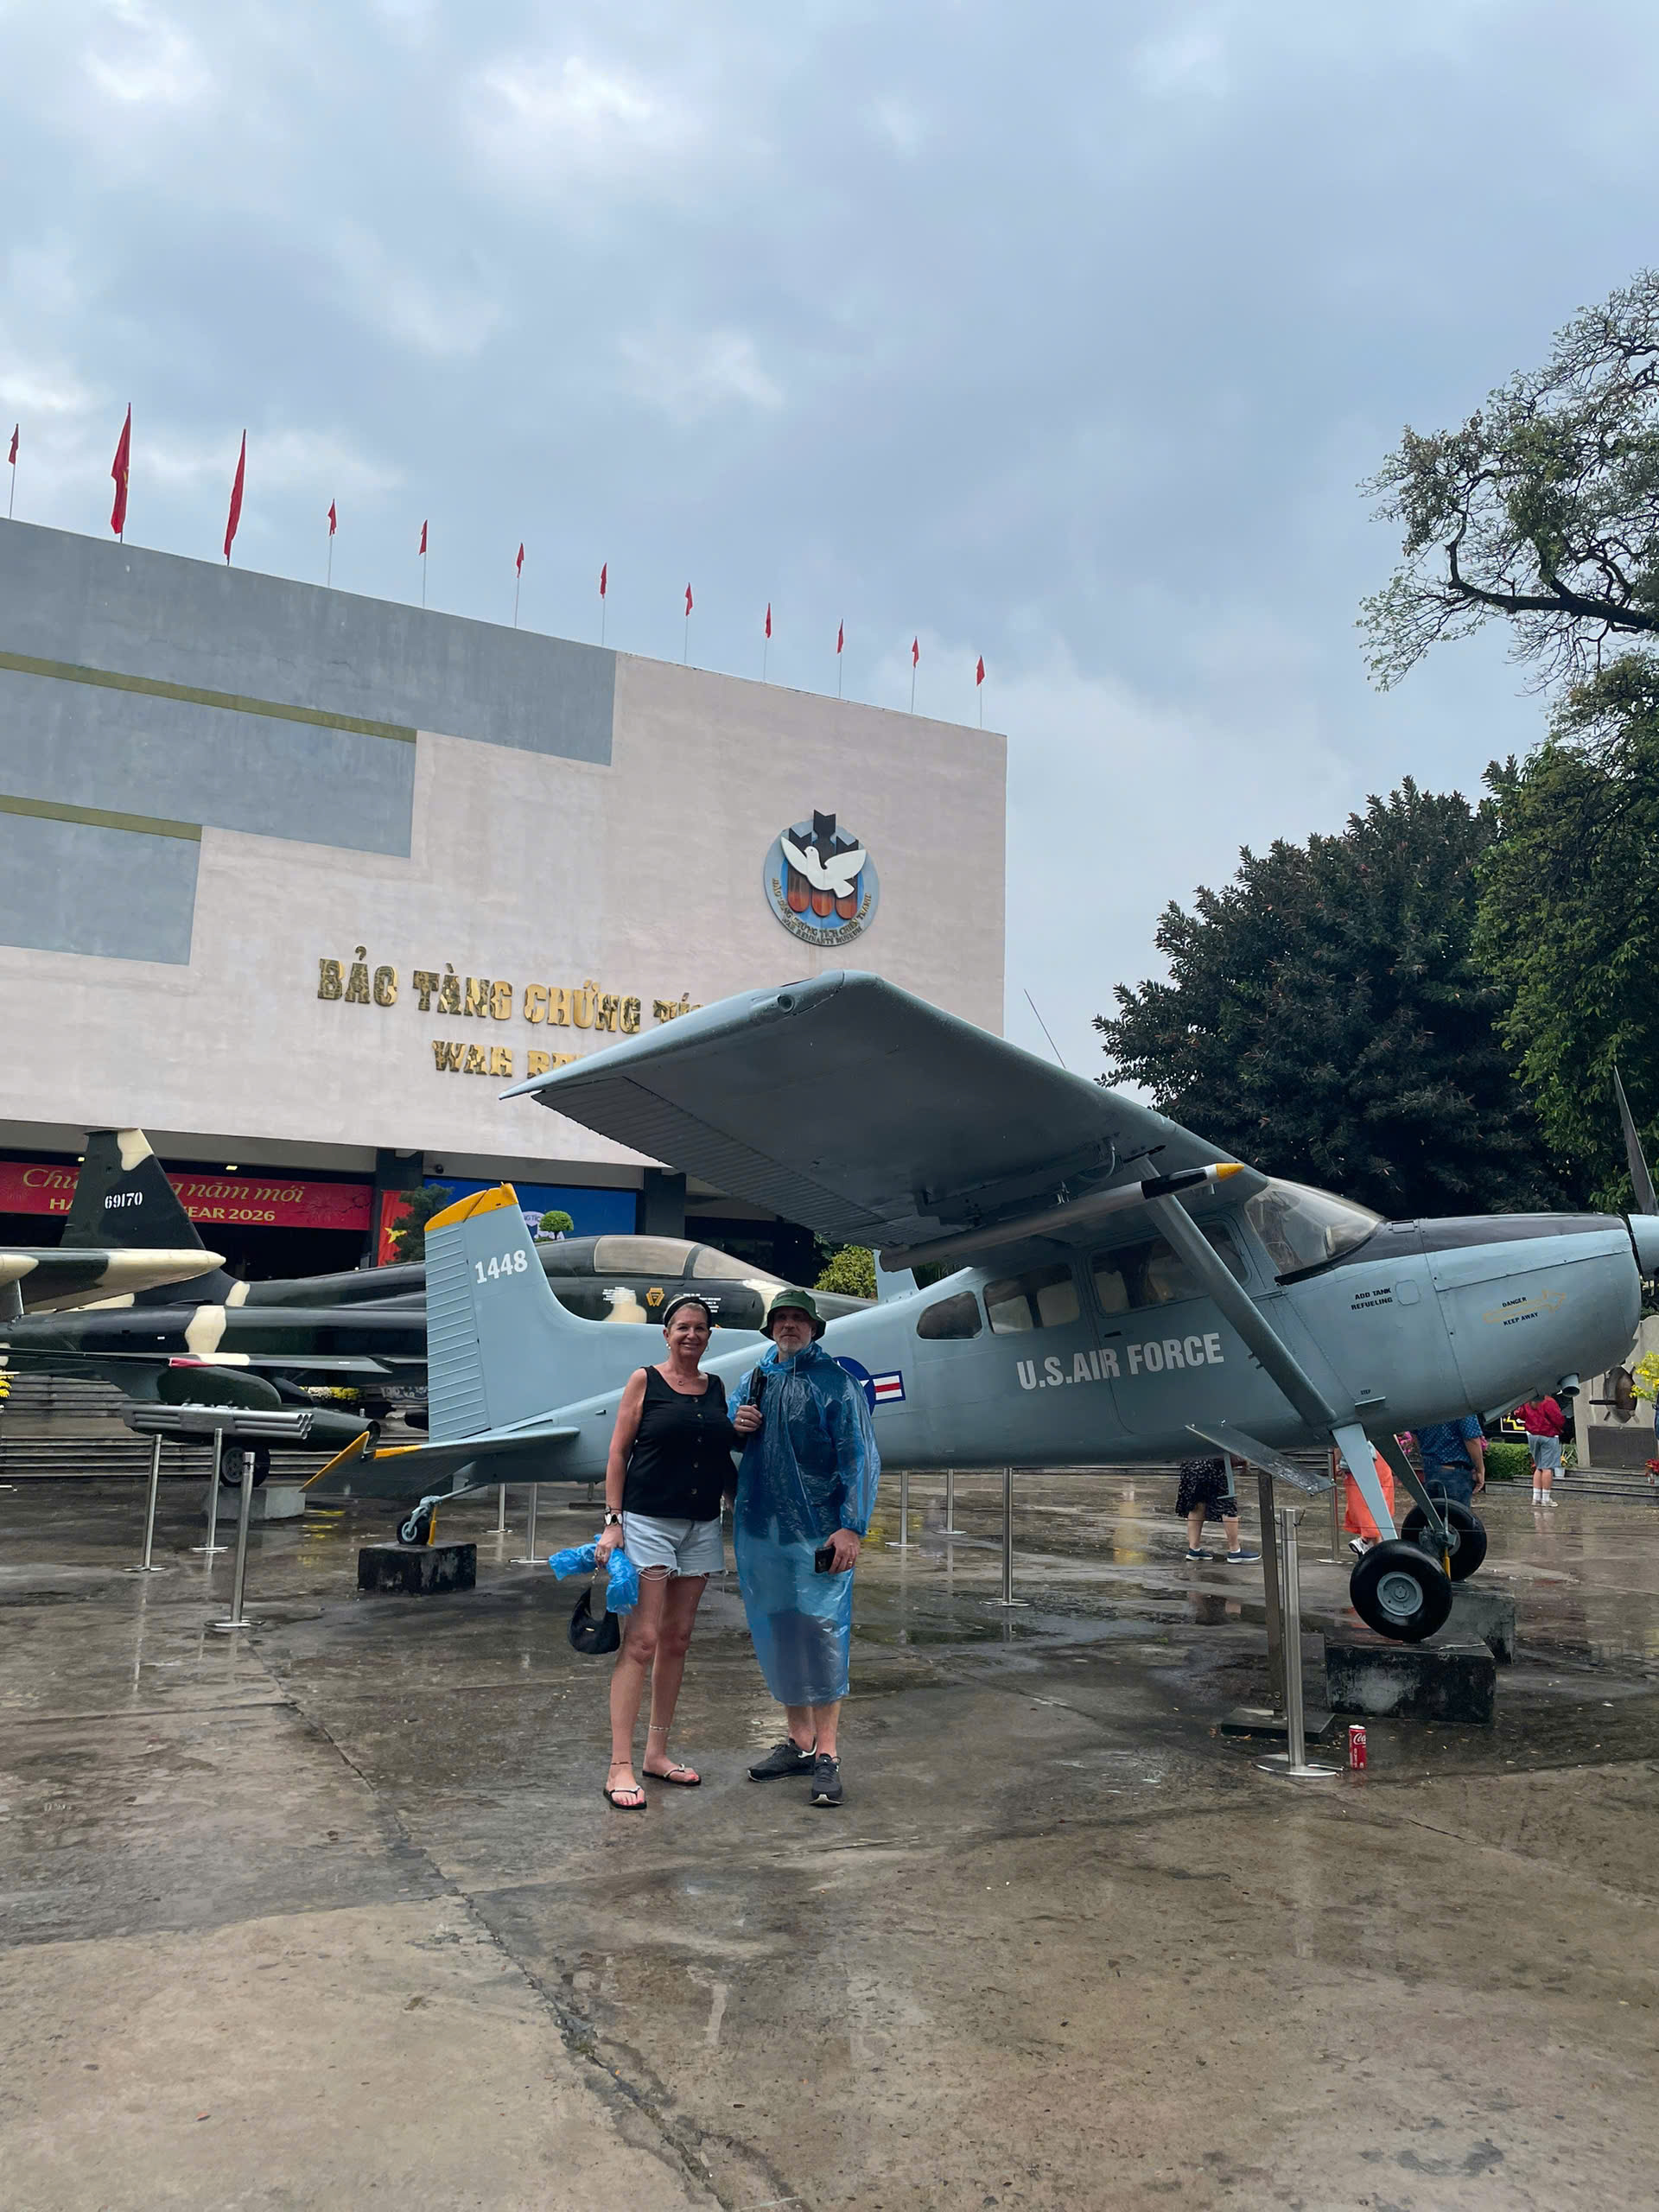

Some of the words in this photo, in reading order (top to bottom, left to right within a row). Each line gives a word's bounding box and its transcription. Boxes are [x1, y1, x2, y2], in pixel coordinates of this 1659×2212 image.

[317, 945, 398, 1007] BẢO
[412, 963, 512, 1020] TÀNG
[524, 977, 641, 1034] CHỨNG
[432, 1039, 512, 1077] WAR
[105, 1192, 143, 1209] 69170
[187, 1182, 250, 1200] năm
[254, 1185, 305, 1203] mới
[184, 1206, 225, 1219] EAR
[228, 1208, 276, 1222] 2026
[475, 1249, 528, 1284] 1448
[1372, 1287, 1392, 1296] TANK
[1351, 1297, 1393, 1310] REFUELING
[1502, 1297, 1527, 1307] DANGER
[1503, 1317, 1520, 1326] KEEP
[1521, 1312, 1538, 1321] AWAY
[1127, 1332, 1224, 1375] FORCE
